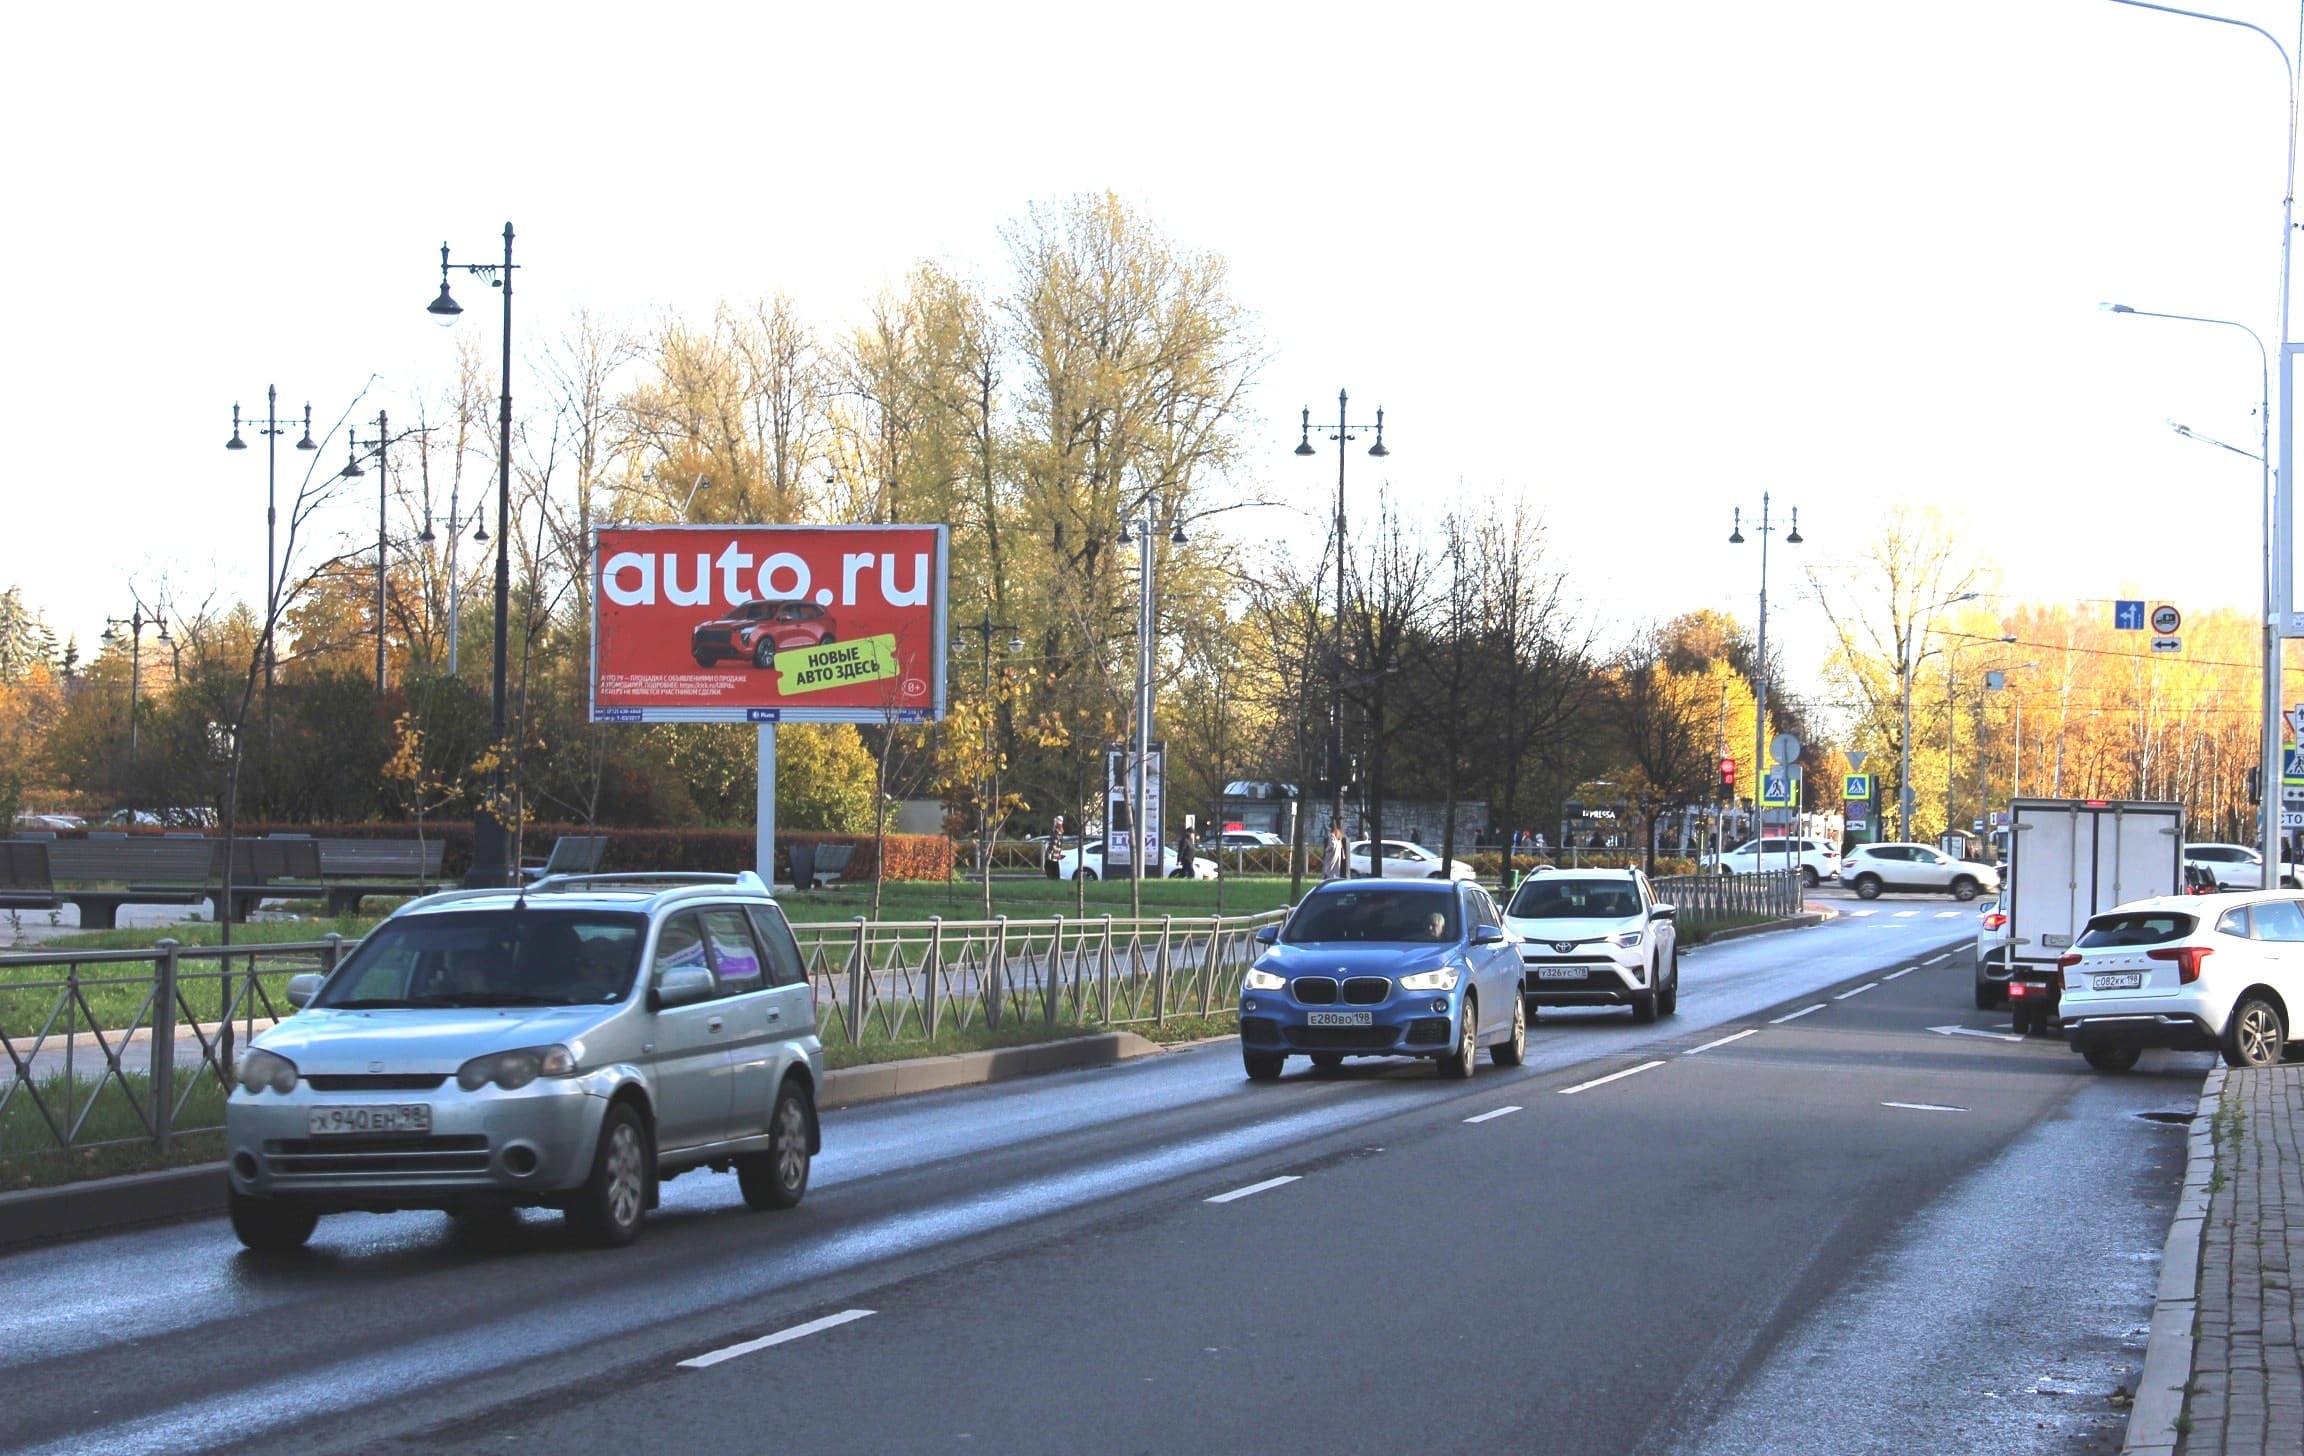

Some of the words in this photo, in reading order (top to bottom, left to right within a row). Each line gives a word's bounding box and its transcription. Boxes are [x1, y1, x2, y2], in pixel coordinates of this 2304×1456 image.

[602, 540, 928, 607] auto.ru
[808, 647, 861, 669] НОВЫЕ
[796, 667, 834, 687] АВТО
[836, 659, 881, 681] ЗДЕСЬ
